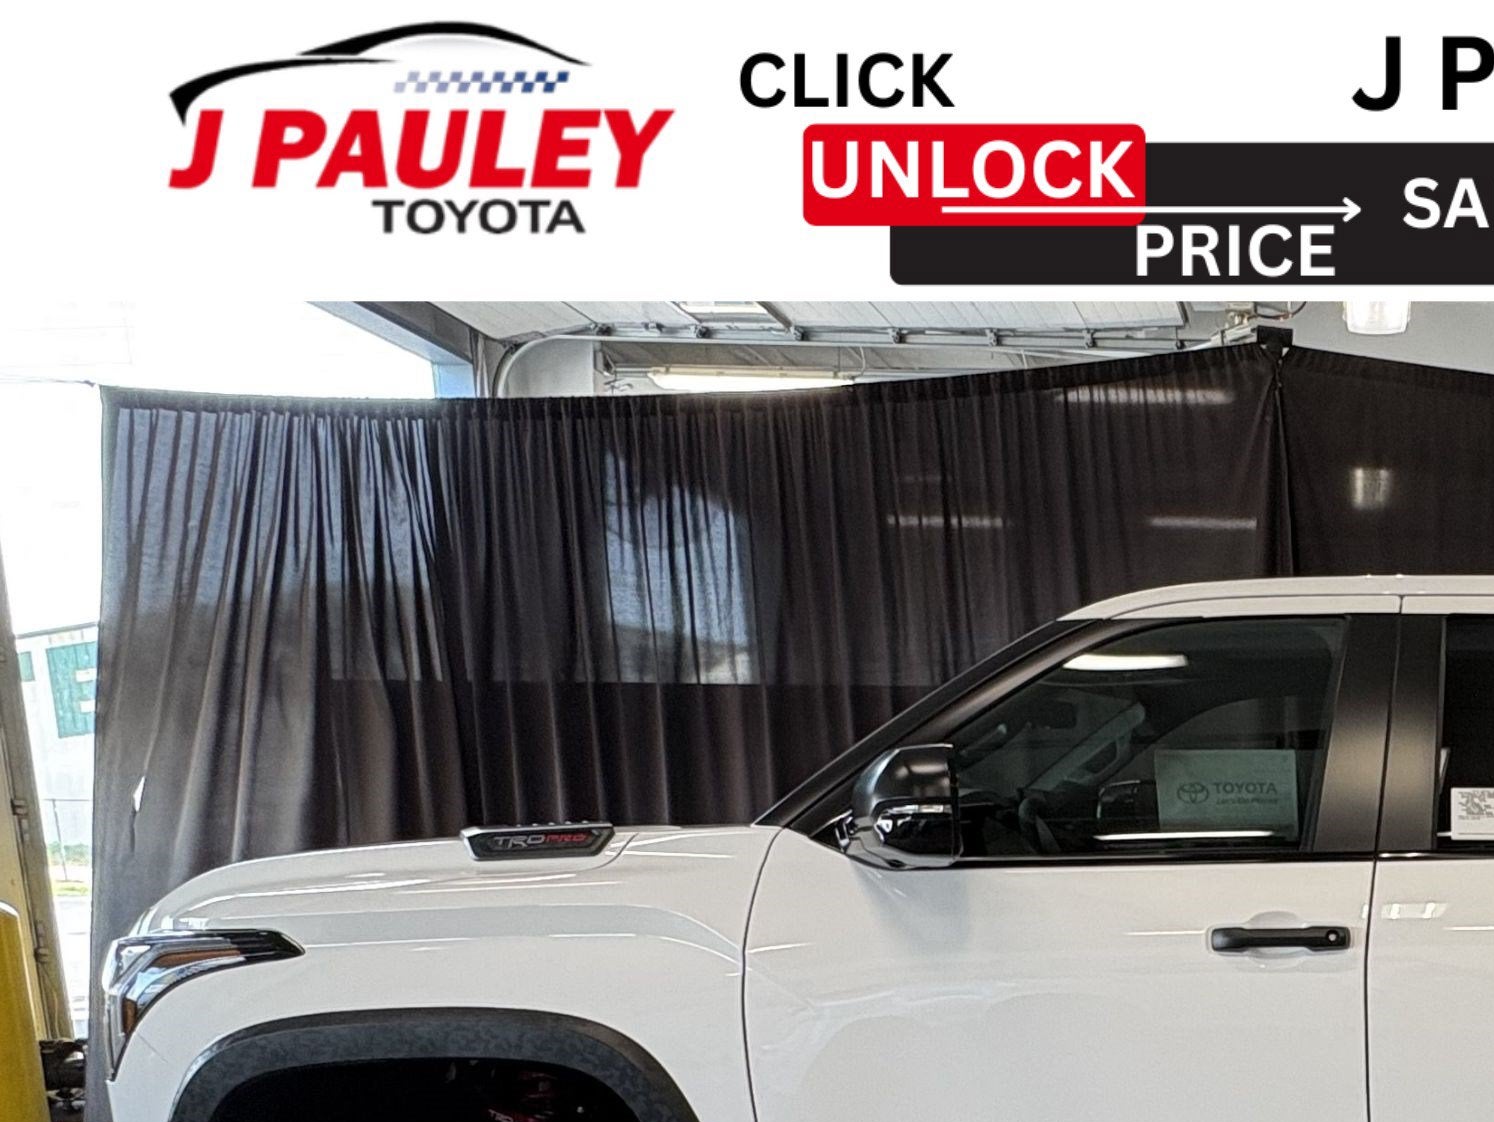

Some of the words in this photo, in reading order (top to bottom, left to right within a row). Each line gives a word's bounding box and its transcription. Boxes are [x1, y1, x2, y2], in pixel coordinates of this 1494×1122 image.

[1214, 782, 1277, 794] TOYOTA
[493, 834, 546, 849] TRD
[546, 832, 587, 843] PRO
